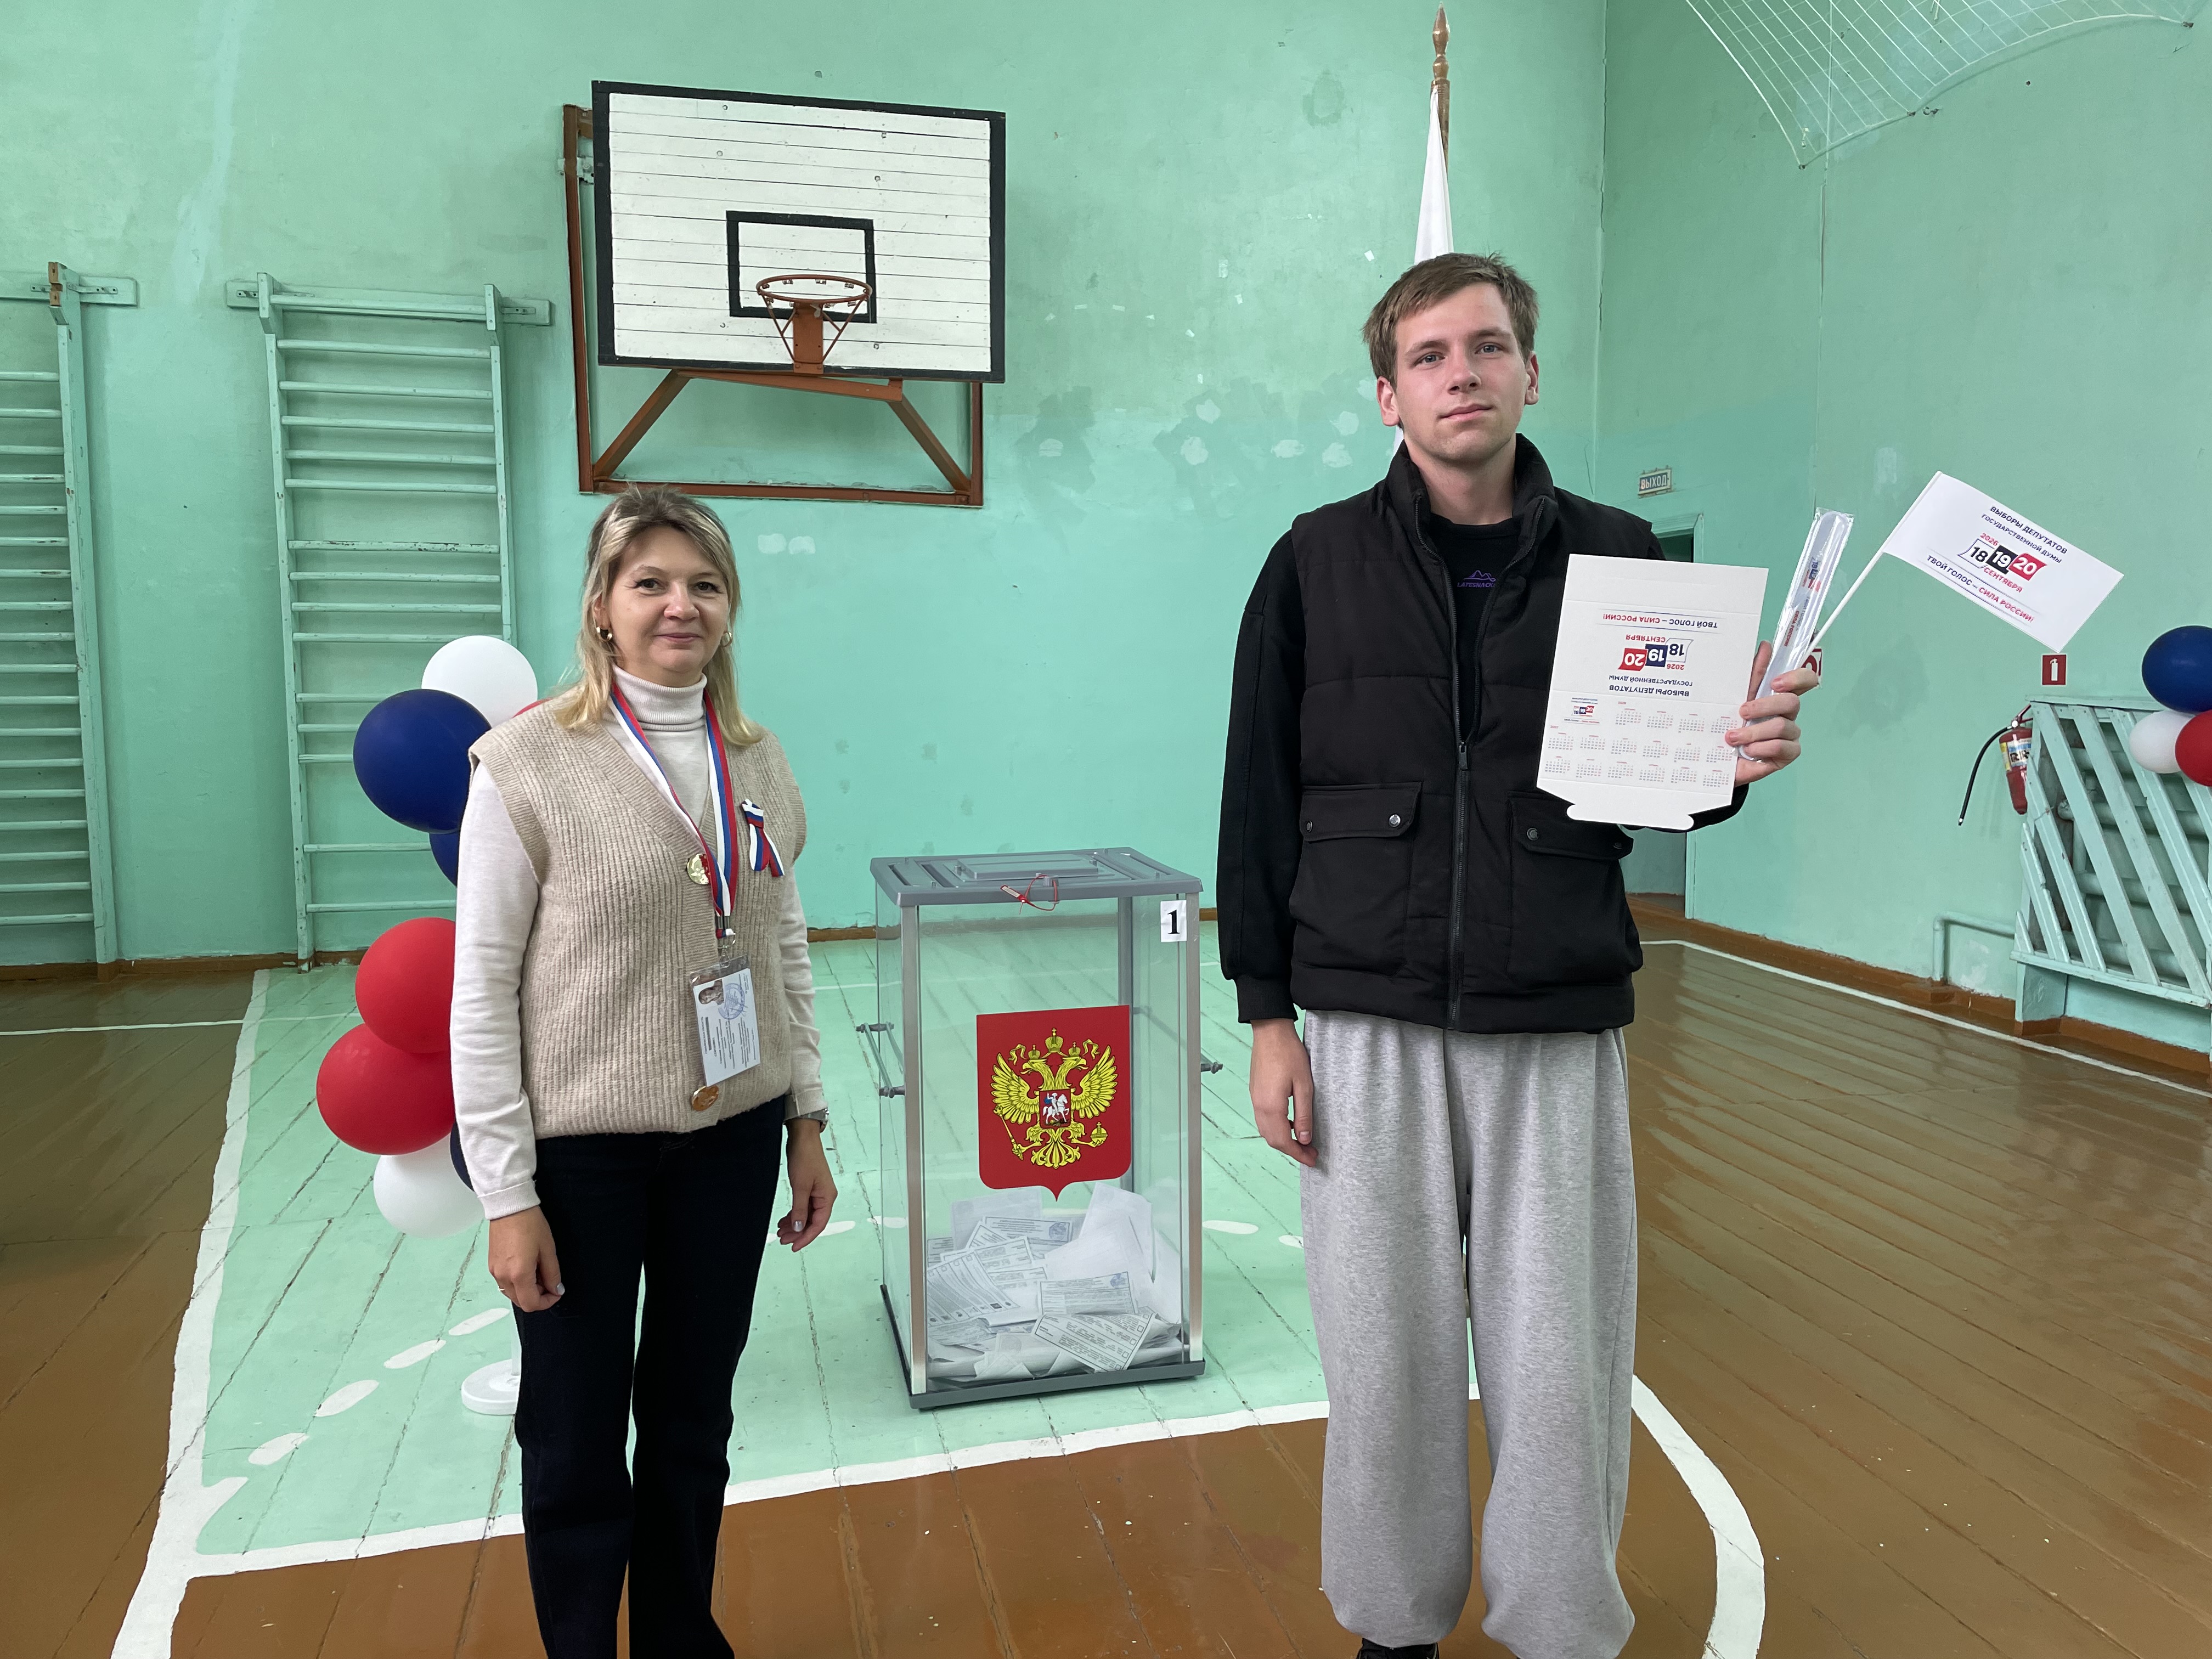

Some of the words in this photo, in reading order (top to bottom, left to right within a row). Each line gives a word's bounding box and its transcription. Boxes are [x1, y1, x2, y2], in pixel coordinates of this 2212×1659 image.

[1641, 475, 1667, 489] ВЫХОД
[1990, 506, 2024, 529] ВЫБОРЫ
[2023, 525, 2068, 554] ДЕПУТАТОВ
[1979, 533, 1999, 546] 2026
[1981, 514, 2042, 553] ГОСУДАРСТВЕННОЙ
[2041, 549, 2062, 564] ДУМЫ
[1970, 546, 1988, 564] 18
[1992, 550, 2009, 568] 19
[2013, 556, 2038, 575] 20
[1984, 567, 2023, 593] СЕНТЯБРЯ
[1927, 555, 1948, 571] ТВОЙ
[1948, 568, 1972, 586] ГОЛОС
[1979, 587, 1999, 603] СИЛА
[2000, 599, 2035, 623] РОССИИ!
[1603, 614, 1637, 622] РОССИИ!
[1626, 634, 1666, 642] СЕНТЯБРЯ
[1648, 649, 1664, 662] 19
[1669, 644, 1685, 656] 18
[1624, 653, 1645, 666] 20
[1630, 676, 1693, 686] ГОСУДАРСТВЕННОЙ
[1609, 685, 1654, 694] ДЕПУТАТОВ
[1167, 909, 1180, 934] 1
